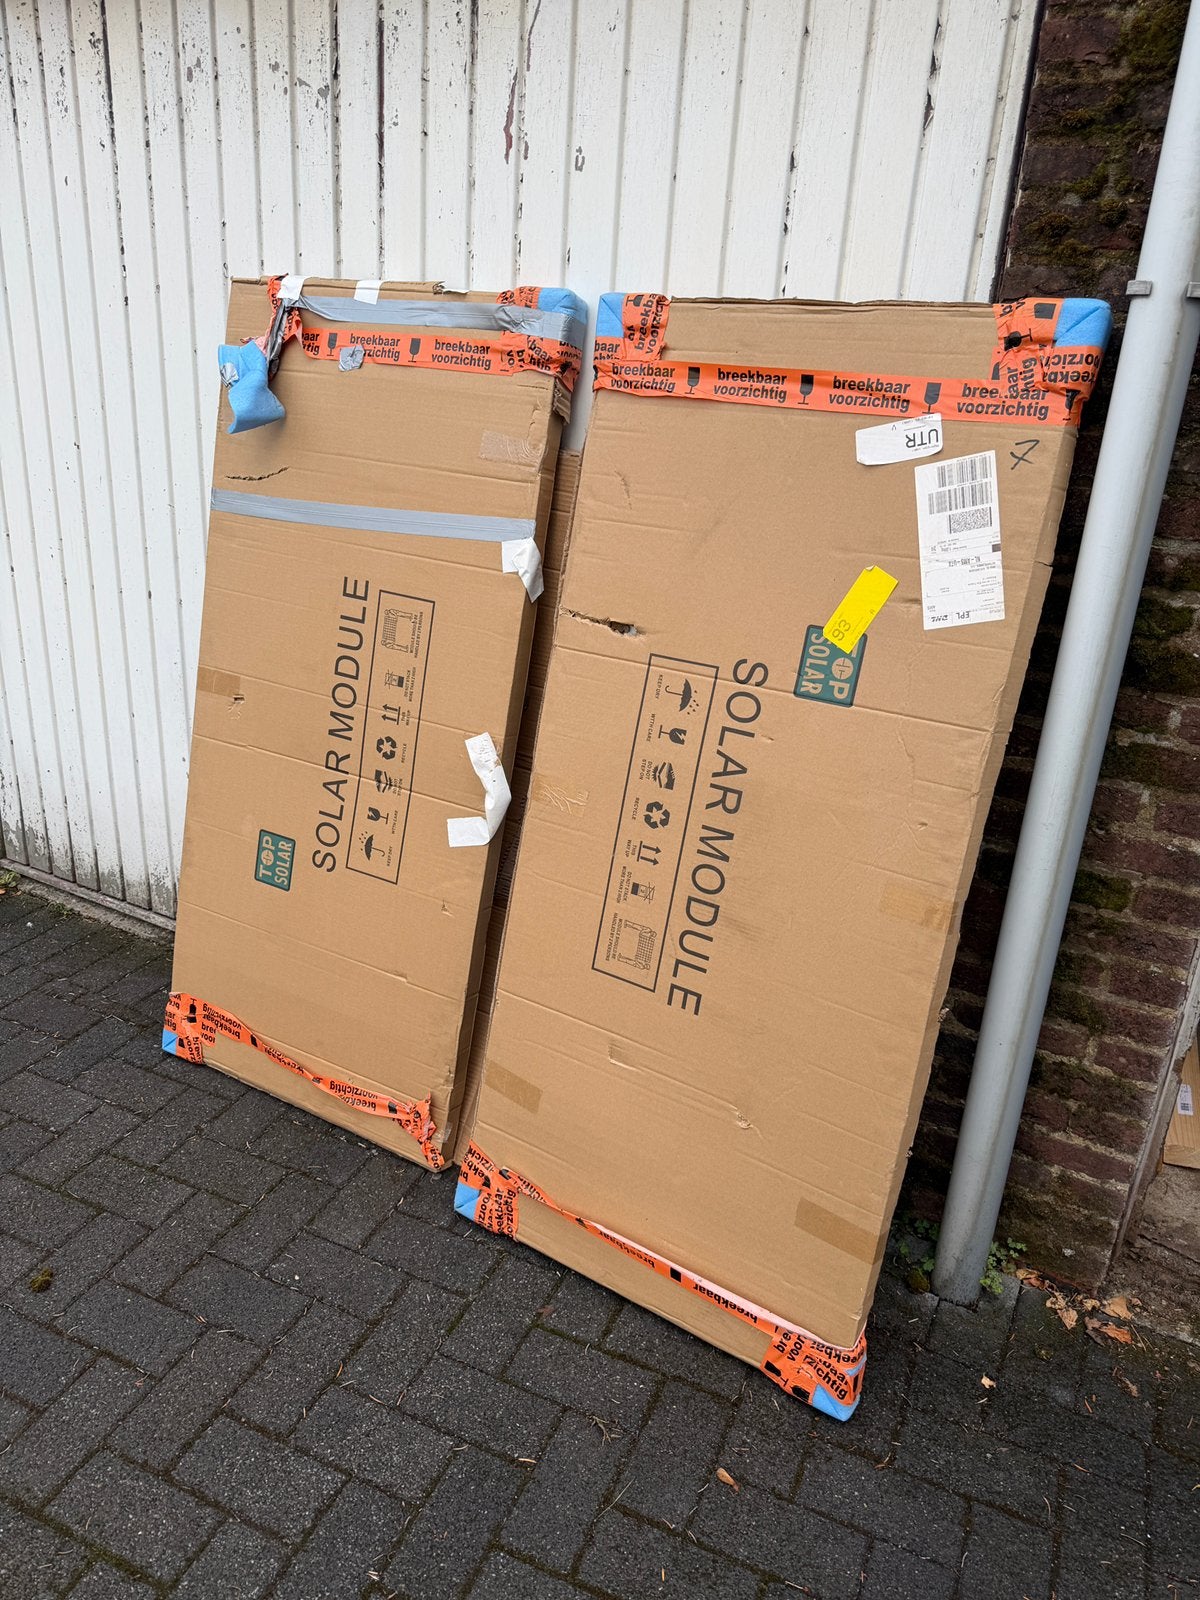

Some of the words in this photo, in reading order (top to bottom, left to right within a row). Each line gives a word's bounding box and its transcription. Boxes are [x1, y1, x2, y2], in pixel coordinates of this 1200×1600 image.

[350, 333, 400, 347] breekbaar
[435, 339, 491, 354] breekbaar
[364, 347, 400, 361] rzichtig
[432, 354, 492, 370] voorzichtig
[612, 363, 675, 378] breekbaar
[717, 368, 787, 386] breekbaar
[611, 378, 676, 393] voorzichtig
[713, 384, 787, 404] voorzichtig
[832, 376, 911, 394] breekbaar
[828, 392, 910, 413] voorzichtig
[957, 401, 1049, 421] voorzichtig
[905, 428, 939, 448] UTR
[956, 612, 970, 620] EPL
[832, 619, 851, 642] 93
[328, 576, 370, 741] MODULE
[800, 633, 830, 694] SOLAR
[705, 659, 768, 814] SOLAR
[647, 761, 652, 769] DO
[312, 750, 352, 873] SOLAR
[258, 836, 276, 878] TOP
[274, 841, 292, 886] SOLAR
[667, 824, 734, 1016] MODULE
[804, 1355, 848, 1400] rzichtig
